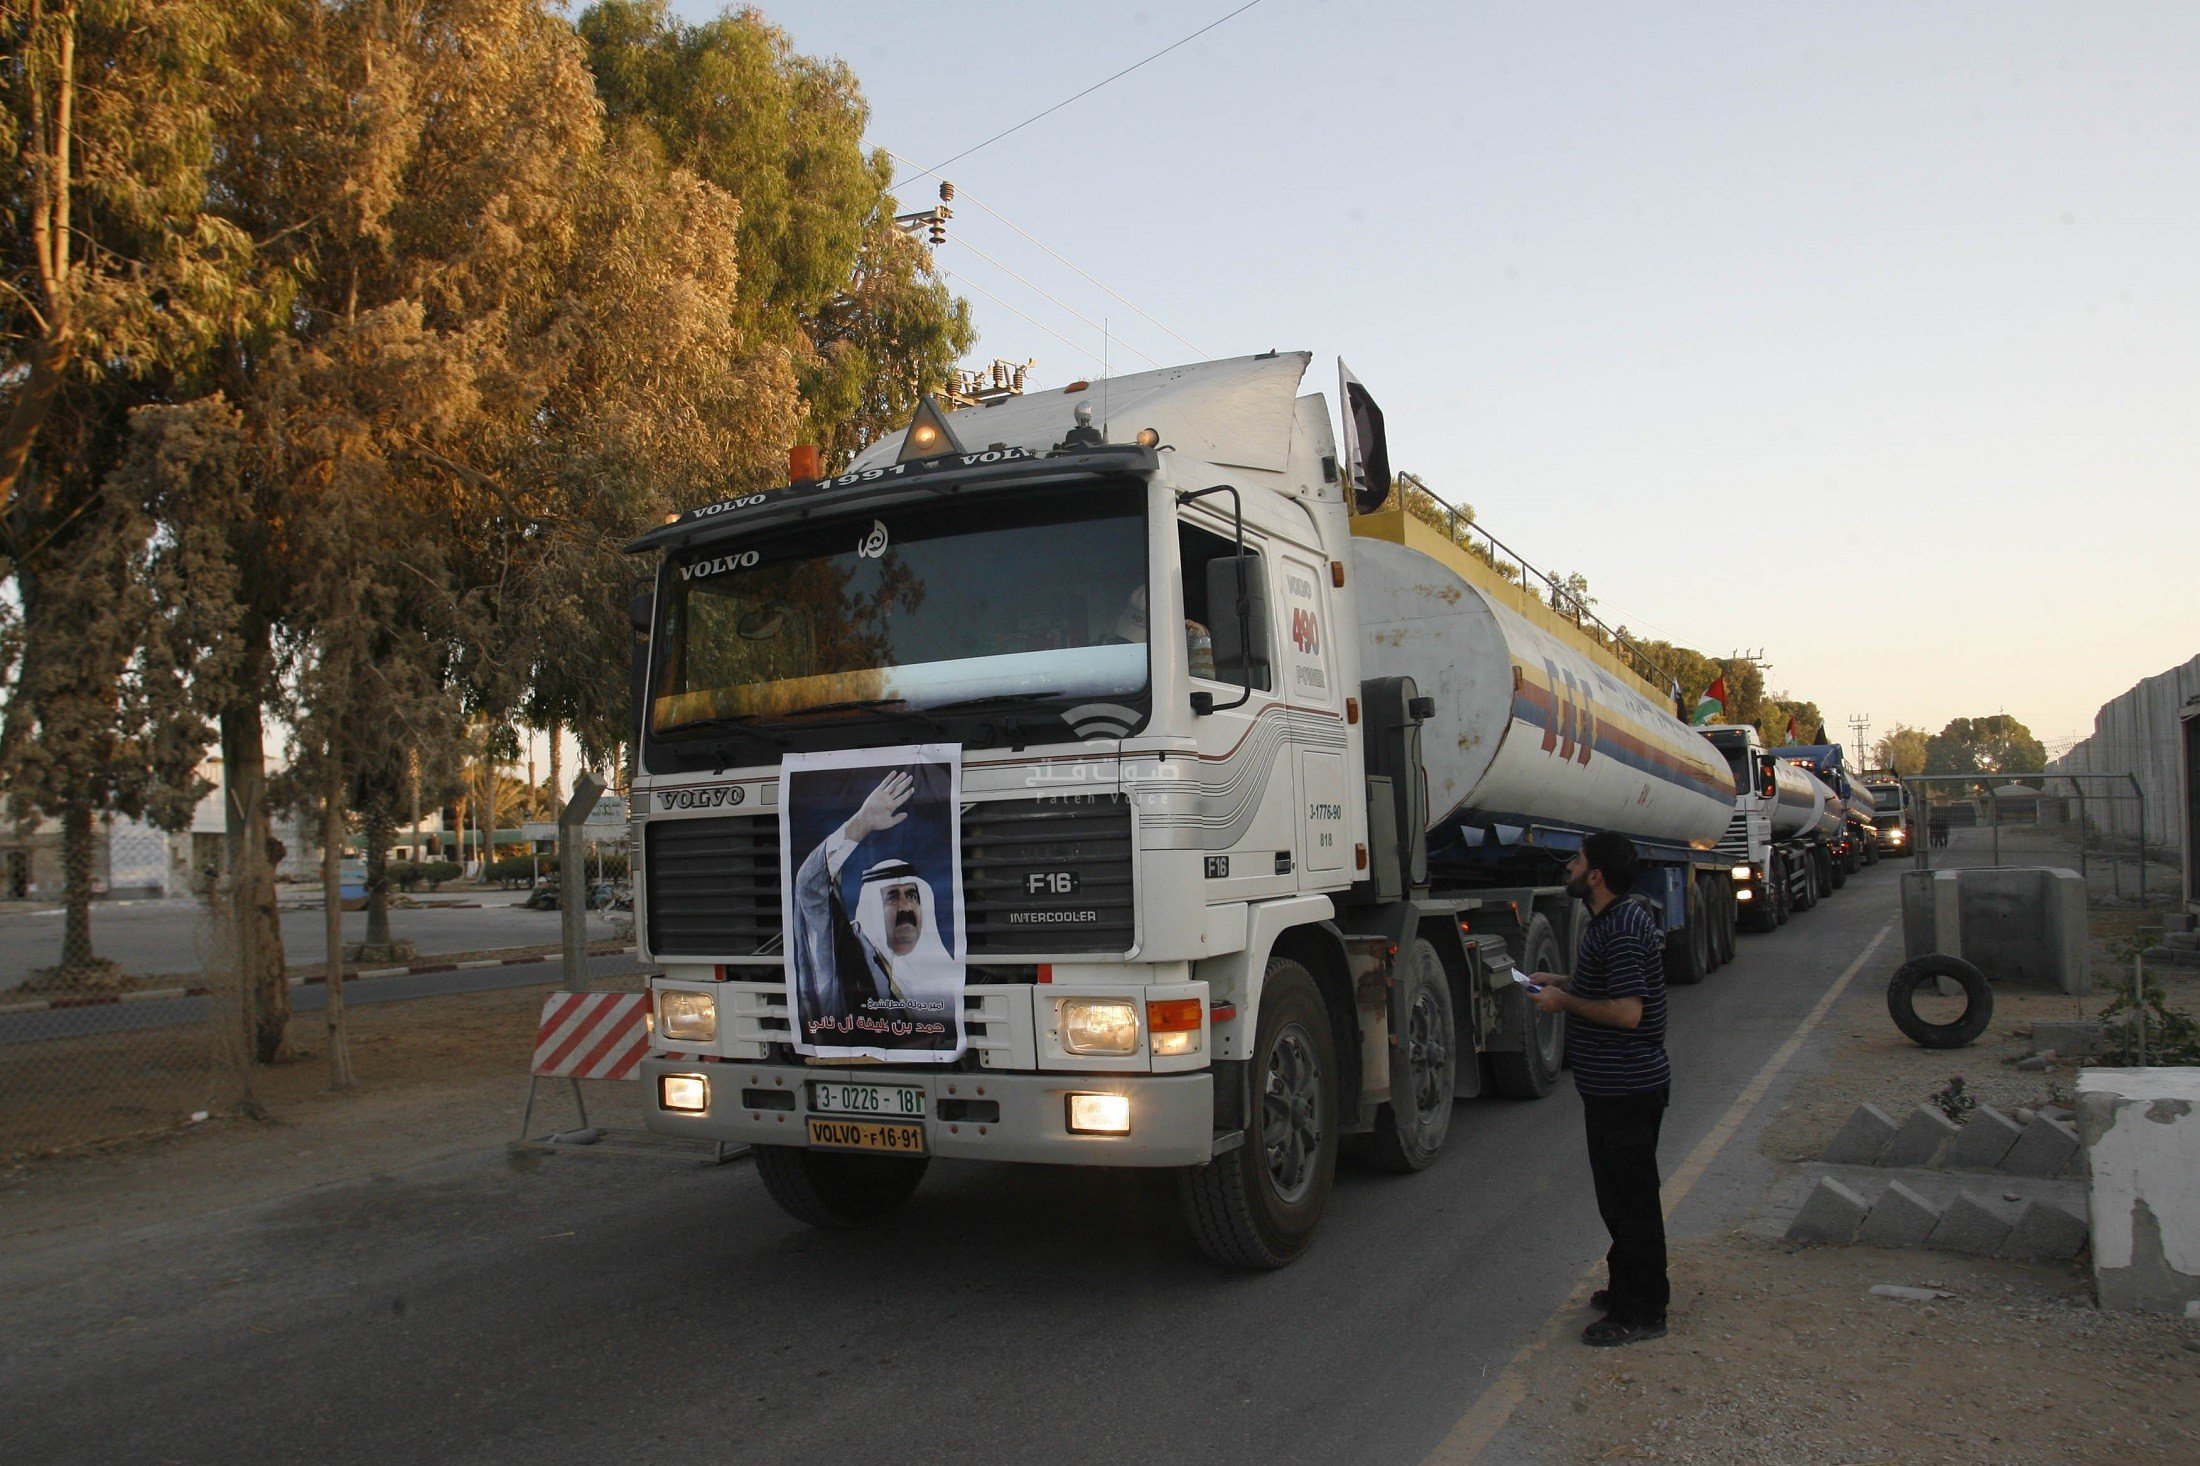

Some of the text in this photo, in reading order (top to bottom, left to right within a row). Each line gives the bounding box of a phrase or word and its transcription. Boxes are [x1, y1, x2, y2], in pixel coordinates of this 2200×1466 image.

[692, 447, 1031, 518] VOLVO 1991 VOLV
[679, 550, 761, 581] VOLVO
[1292, 607, 1320, 656] 490
[657, 786, 745, 810] VOLVO
[1309, 804, 1342, 820] 3-1776-90
[1319, 833, 1333, 847] 818
[1208, 857, 1227, 877] F16
[1029, 873, 1072, 894] F16
[1010, 911, 1096, 923] INTERCOOLER
[907, 998, 928, 1012] دولة
[808, 1015, 836, 1034] ثاني
[891, 1018, 913, 1036] بن
[915, 1022, 945, 1034] حمد
